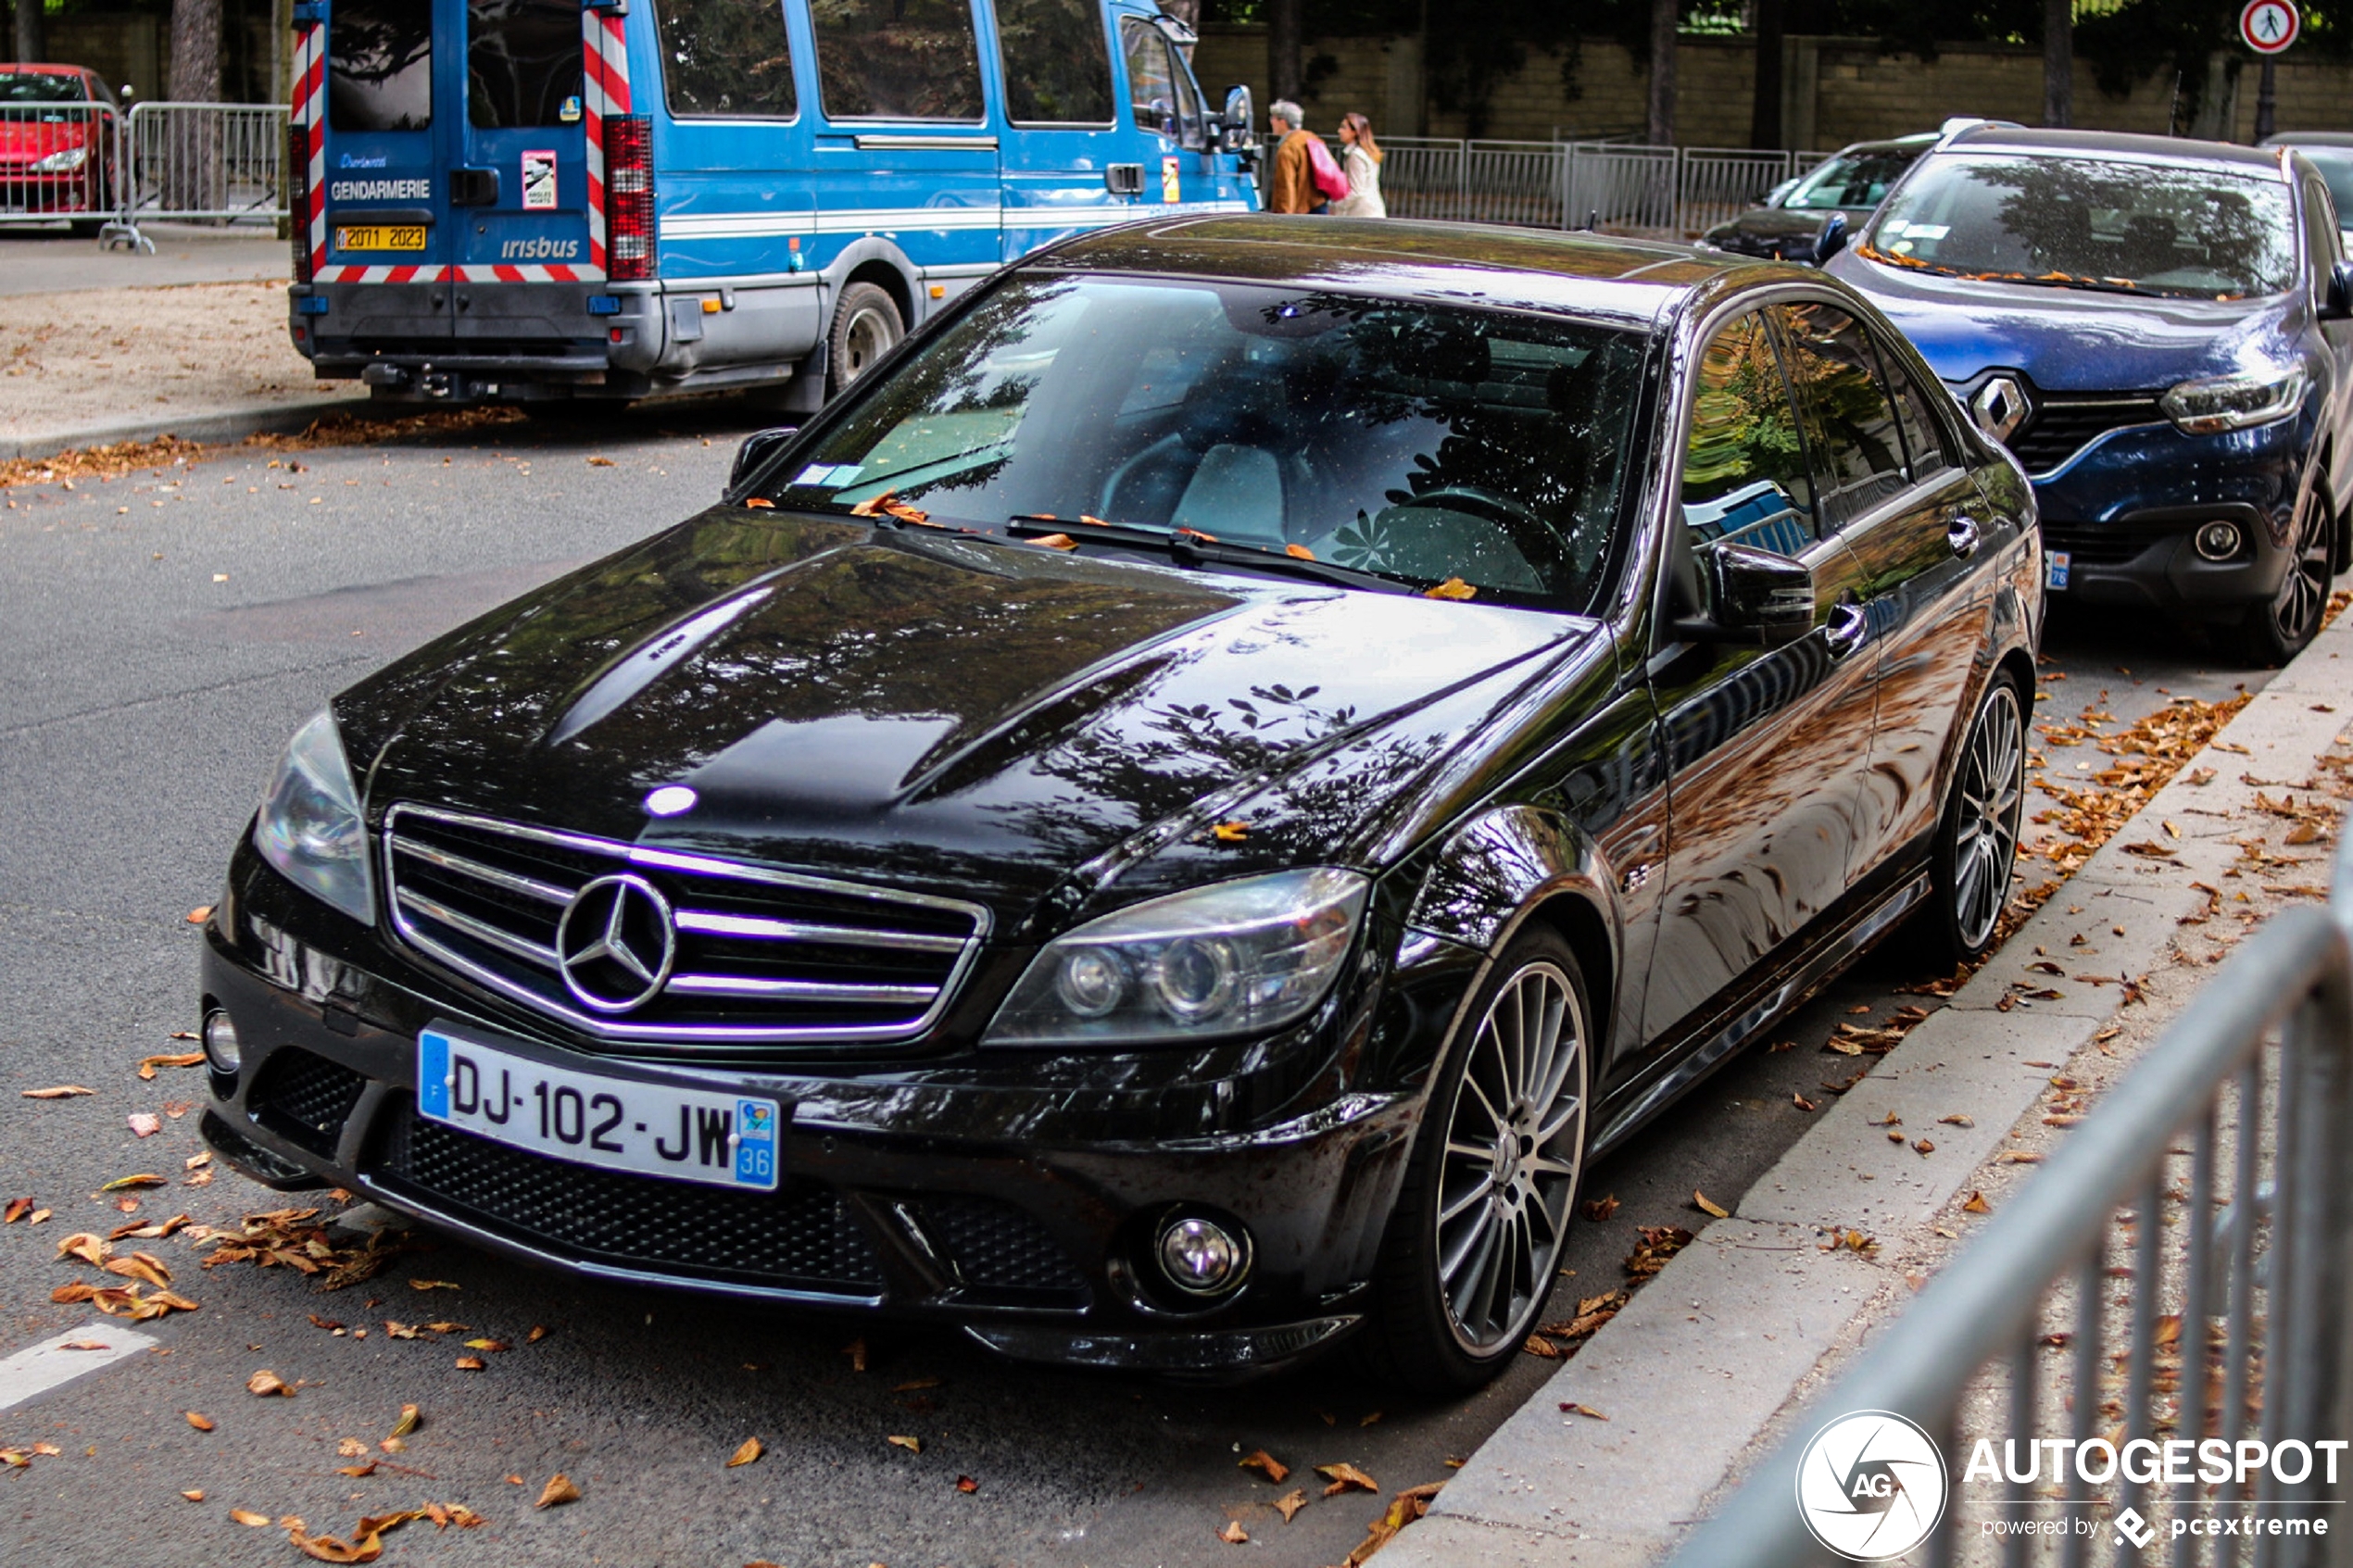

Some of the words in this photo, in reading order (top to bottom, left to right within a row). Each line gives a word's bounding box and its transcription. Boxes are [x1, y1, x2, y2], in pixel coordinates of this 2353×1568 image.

[331, 179, 431, 201] GENDARMERIE
[348, 228, 380, 247] 2071
[389, 227, 423, 247] 2023
[501, 236, 580, 258] irisbus
[453, 1053, 732, 1169] DJ-102-JW
[740, 1147, 770, 1176] 36
